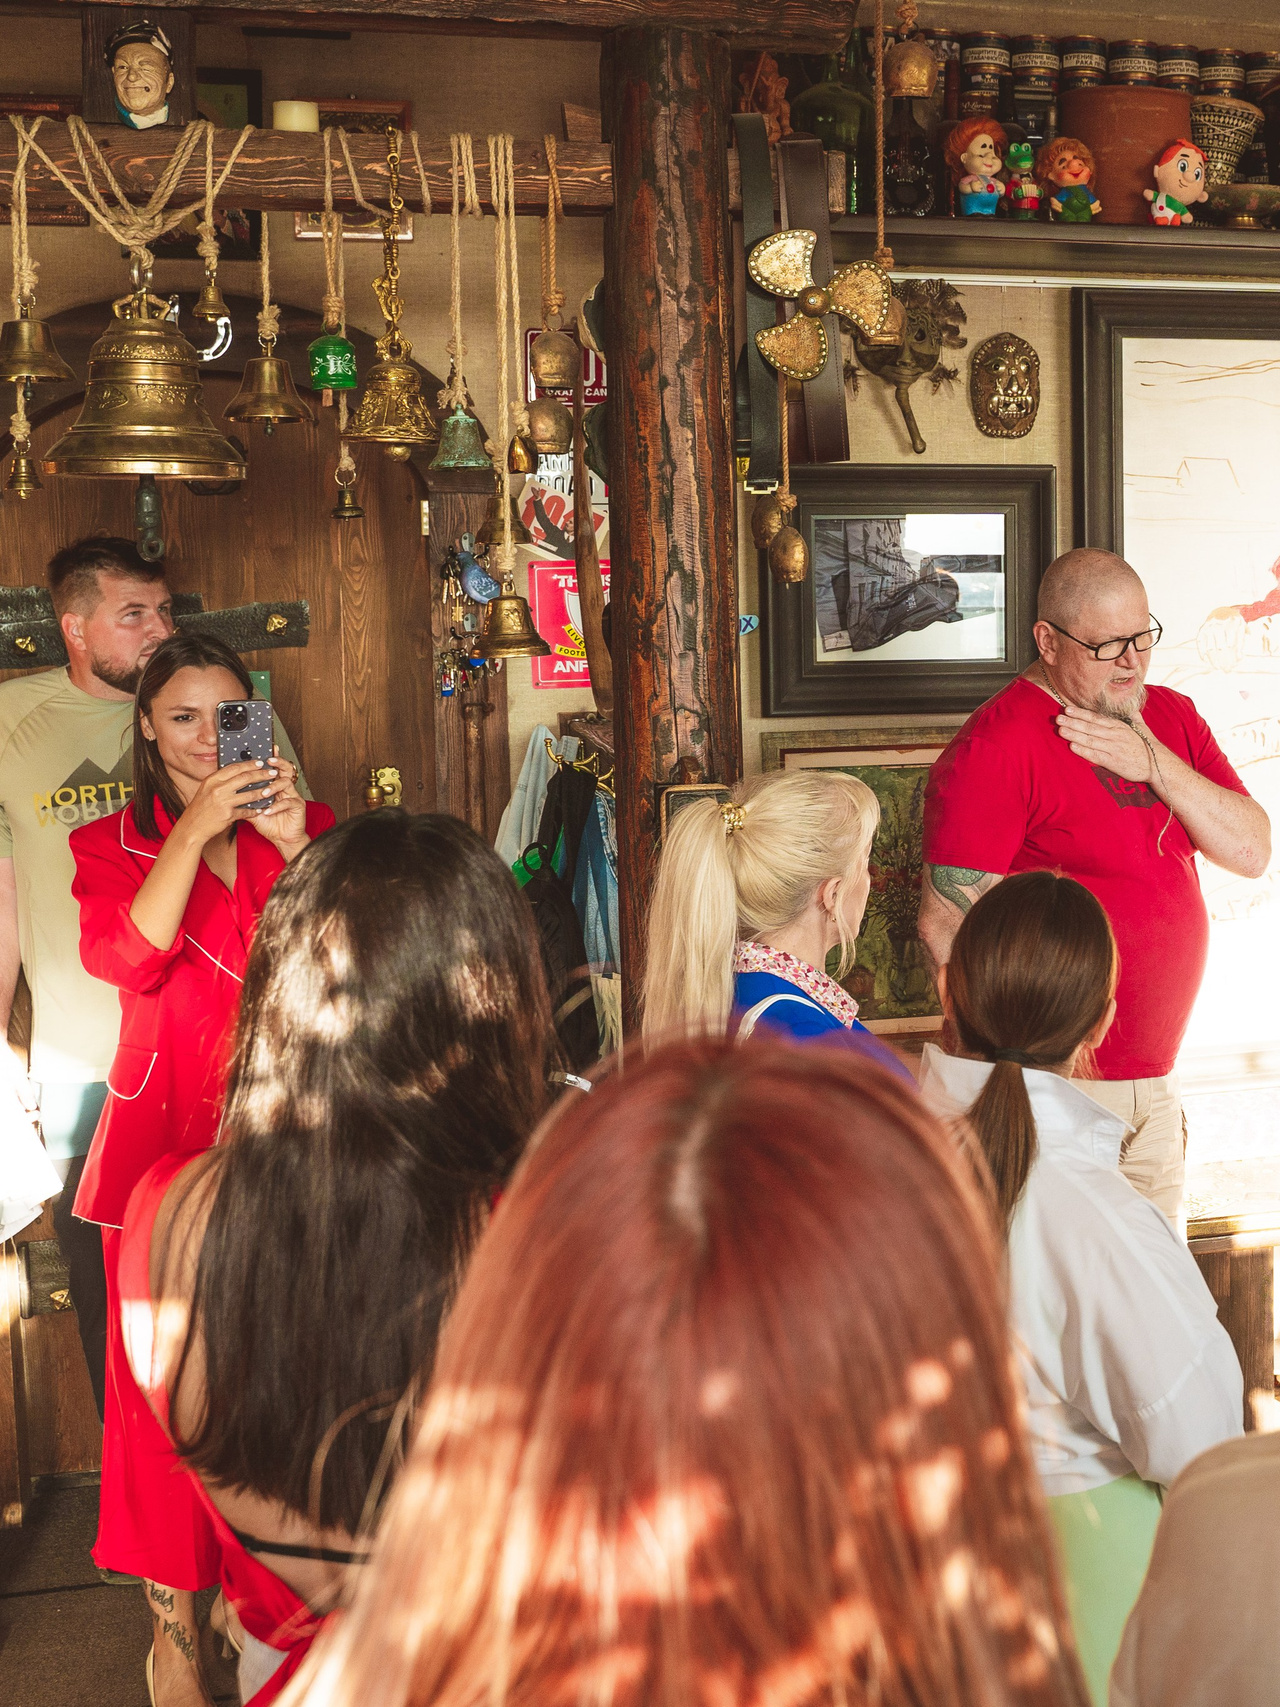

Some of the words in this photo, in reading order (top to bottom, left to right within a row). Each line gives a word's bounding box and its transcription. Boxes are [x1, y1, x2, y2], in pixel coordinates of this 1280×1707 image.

[584, 387, 608, 397] CAN
[558, 646, 586, 658] FOOTB
[552, 660, 589, 674] ANF
